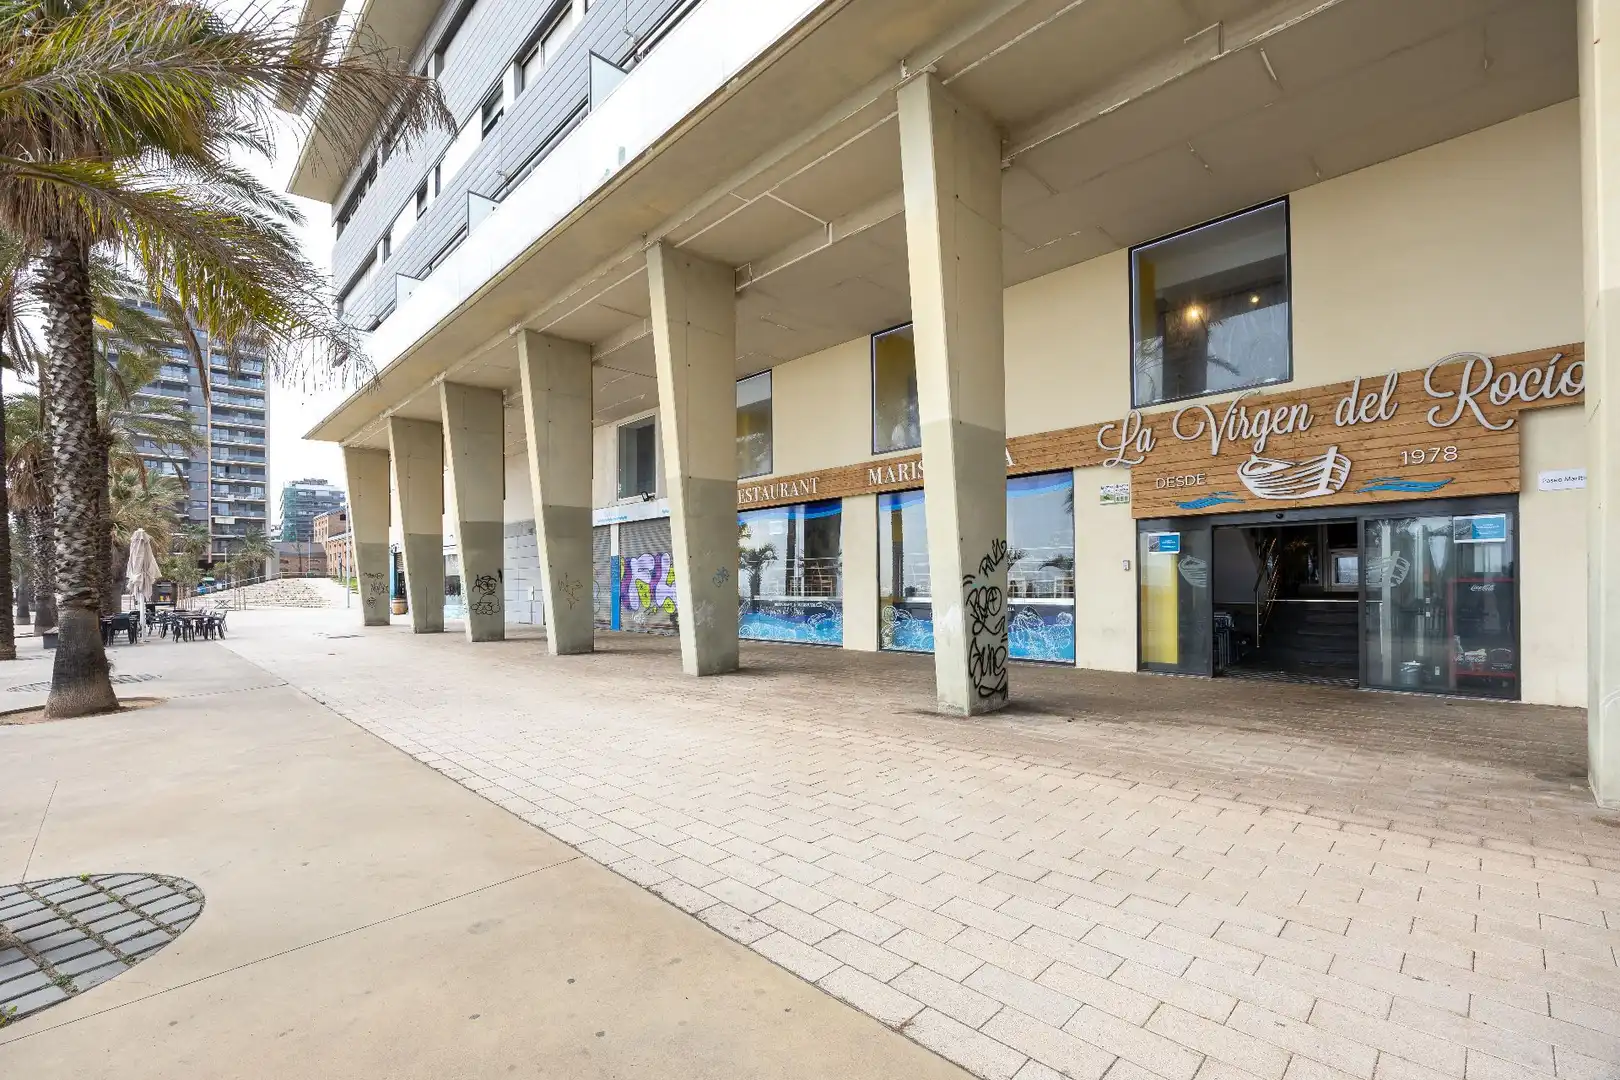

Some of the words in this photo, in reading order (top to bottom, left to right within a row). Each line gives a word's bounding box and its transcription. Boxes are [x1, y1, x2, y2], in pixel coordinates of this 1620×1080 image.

[1097, 408, 1157, 469] La
[1172, 390, 1315, 457] Virgen
[1335, 369, 1399, 427] del
[1423, 351, 1586, 431] Rocío
[1401, 445, 1459, 466] 1978
[737, 476, 821, 504] ESTAURANT
[1156, 472, 1208, 490] DESDE
